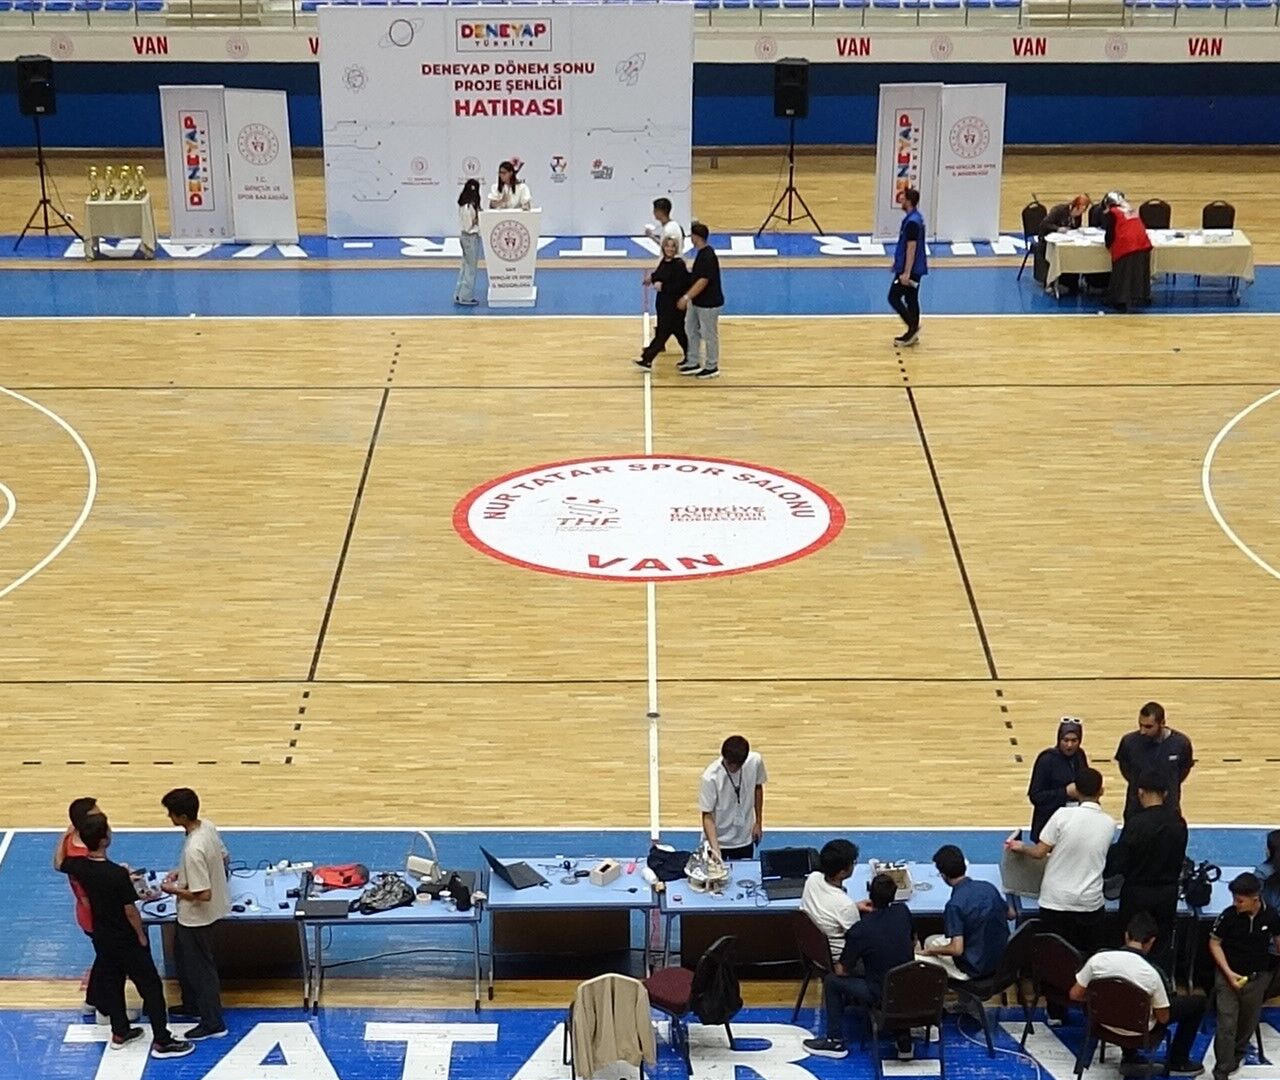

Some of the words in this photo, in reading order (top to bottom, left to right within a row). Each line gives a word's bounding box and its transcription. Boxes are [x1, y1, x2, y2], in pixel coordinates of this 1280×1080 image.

[461, 23, 547, 39] DENEYAP
[133, 36, 170, 54] VAN
[475, 39, 535, 47] TÜRKİYE
[836, 37, 871, 55] VAN
[1012, 38, 1048, 55] VAN
[1188, 38, 1223, 55] VAN
[421, 63, 490, 76] DENEYAP
[494, 60, 550, 75] DÖNEM
[553, 62, 595, 75] SONU
[454, 79, 502, 91] PROJE
[506, 75, 562, 94] ŞENLİĞİ
[454, 98, 563, 117] HATIRASI
[183, 116, 203, 206] DENEYAP
[483, 492, 521, 520] NUR
[512, 465, 616, 491] TATAR
[628, 463, 726, 477] SPOR
[732, 473, 816, 518] SALONU
[670, 504, 766, 514] TÜRKİYE
[556, 517, 621, 526] THF
[587, 553, 725, 572] VAN
